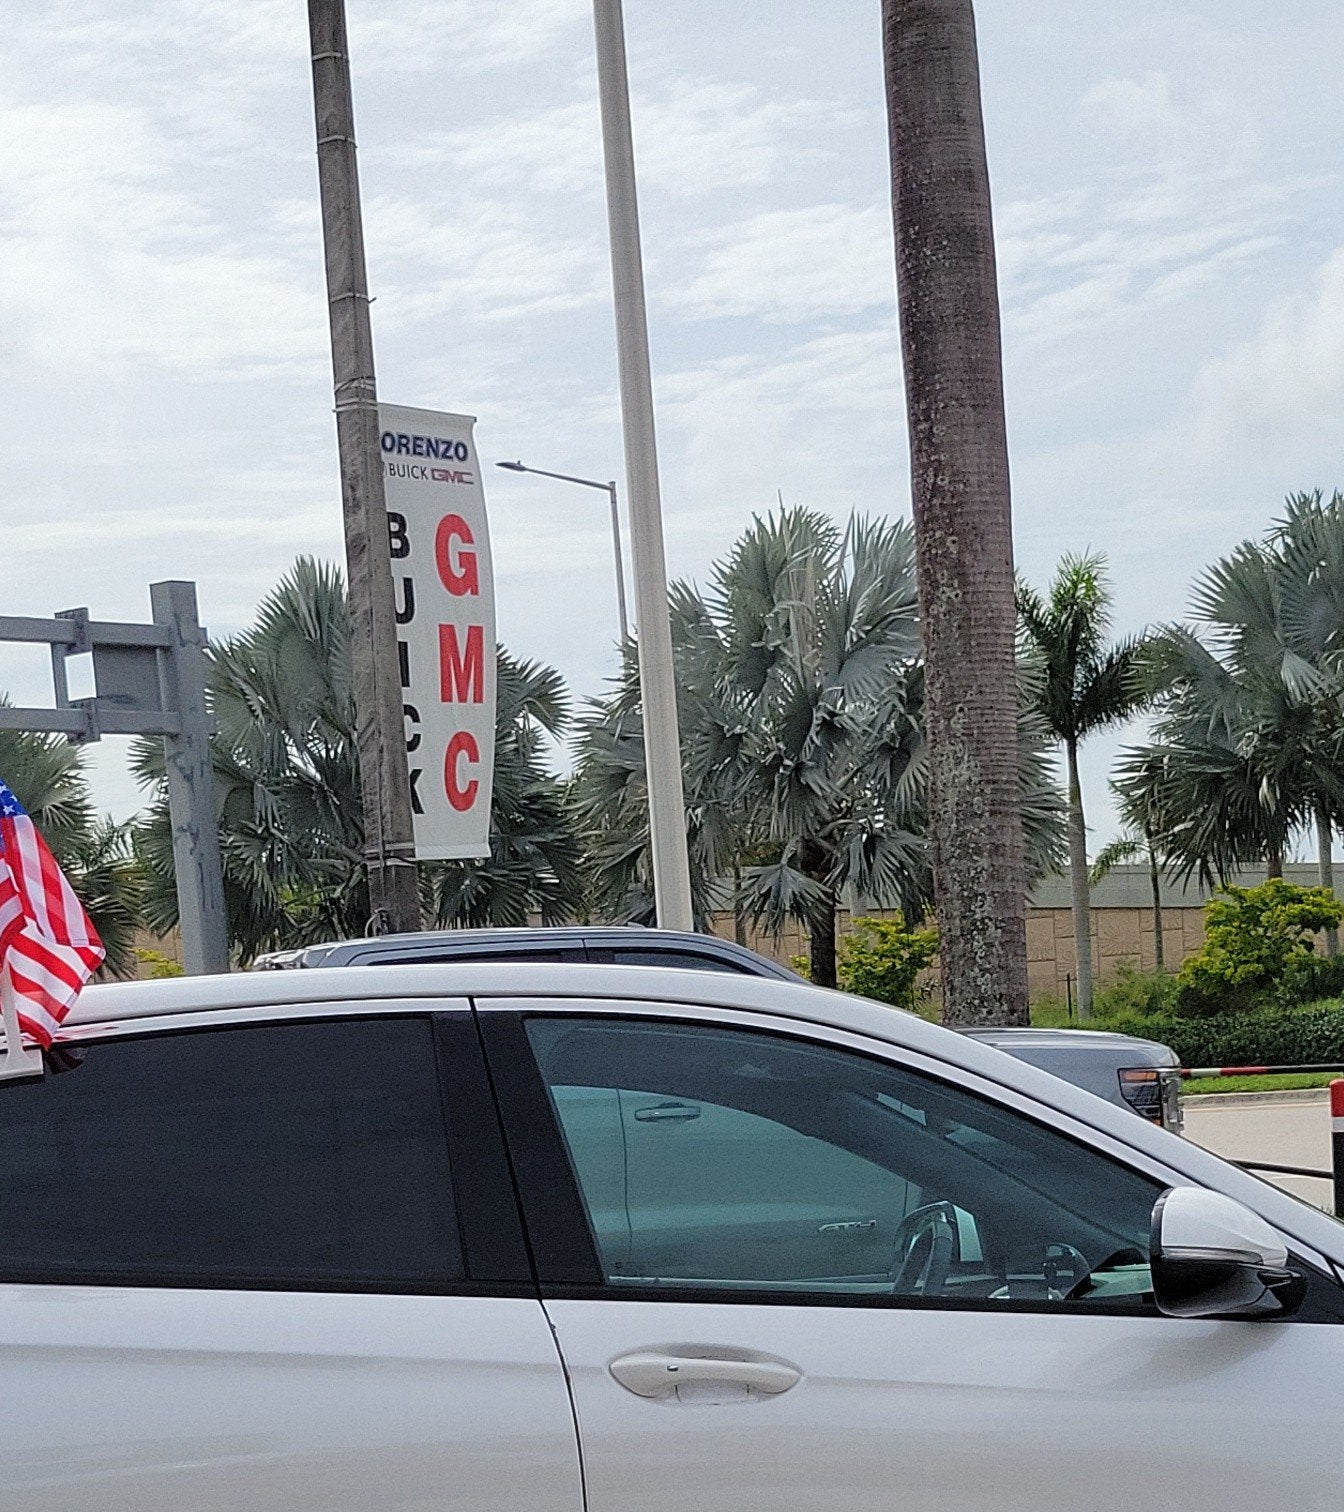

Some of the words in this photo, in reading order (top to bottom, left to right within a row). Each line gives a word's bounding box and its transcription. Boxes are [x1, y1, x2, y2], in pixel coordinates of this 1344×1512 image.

[380, 432, 468, 462] ORENZO
[388, 462, 428, 480] BUICK
[430, 468, 474, 485] GMC
[435, 513, 484, 812] GMC
